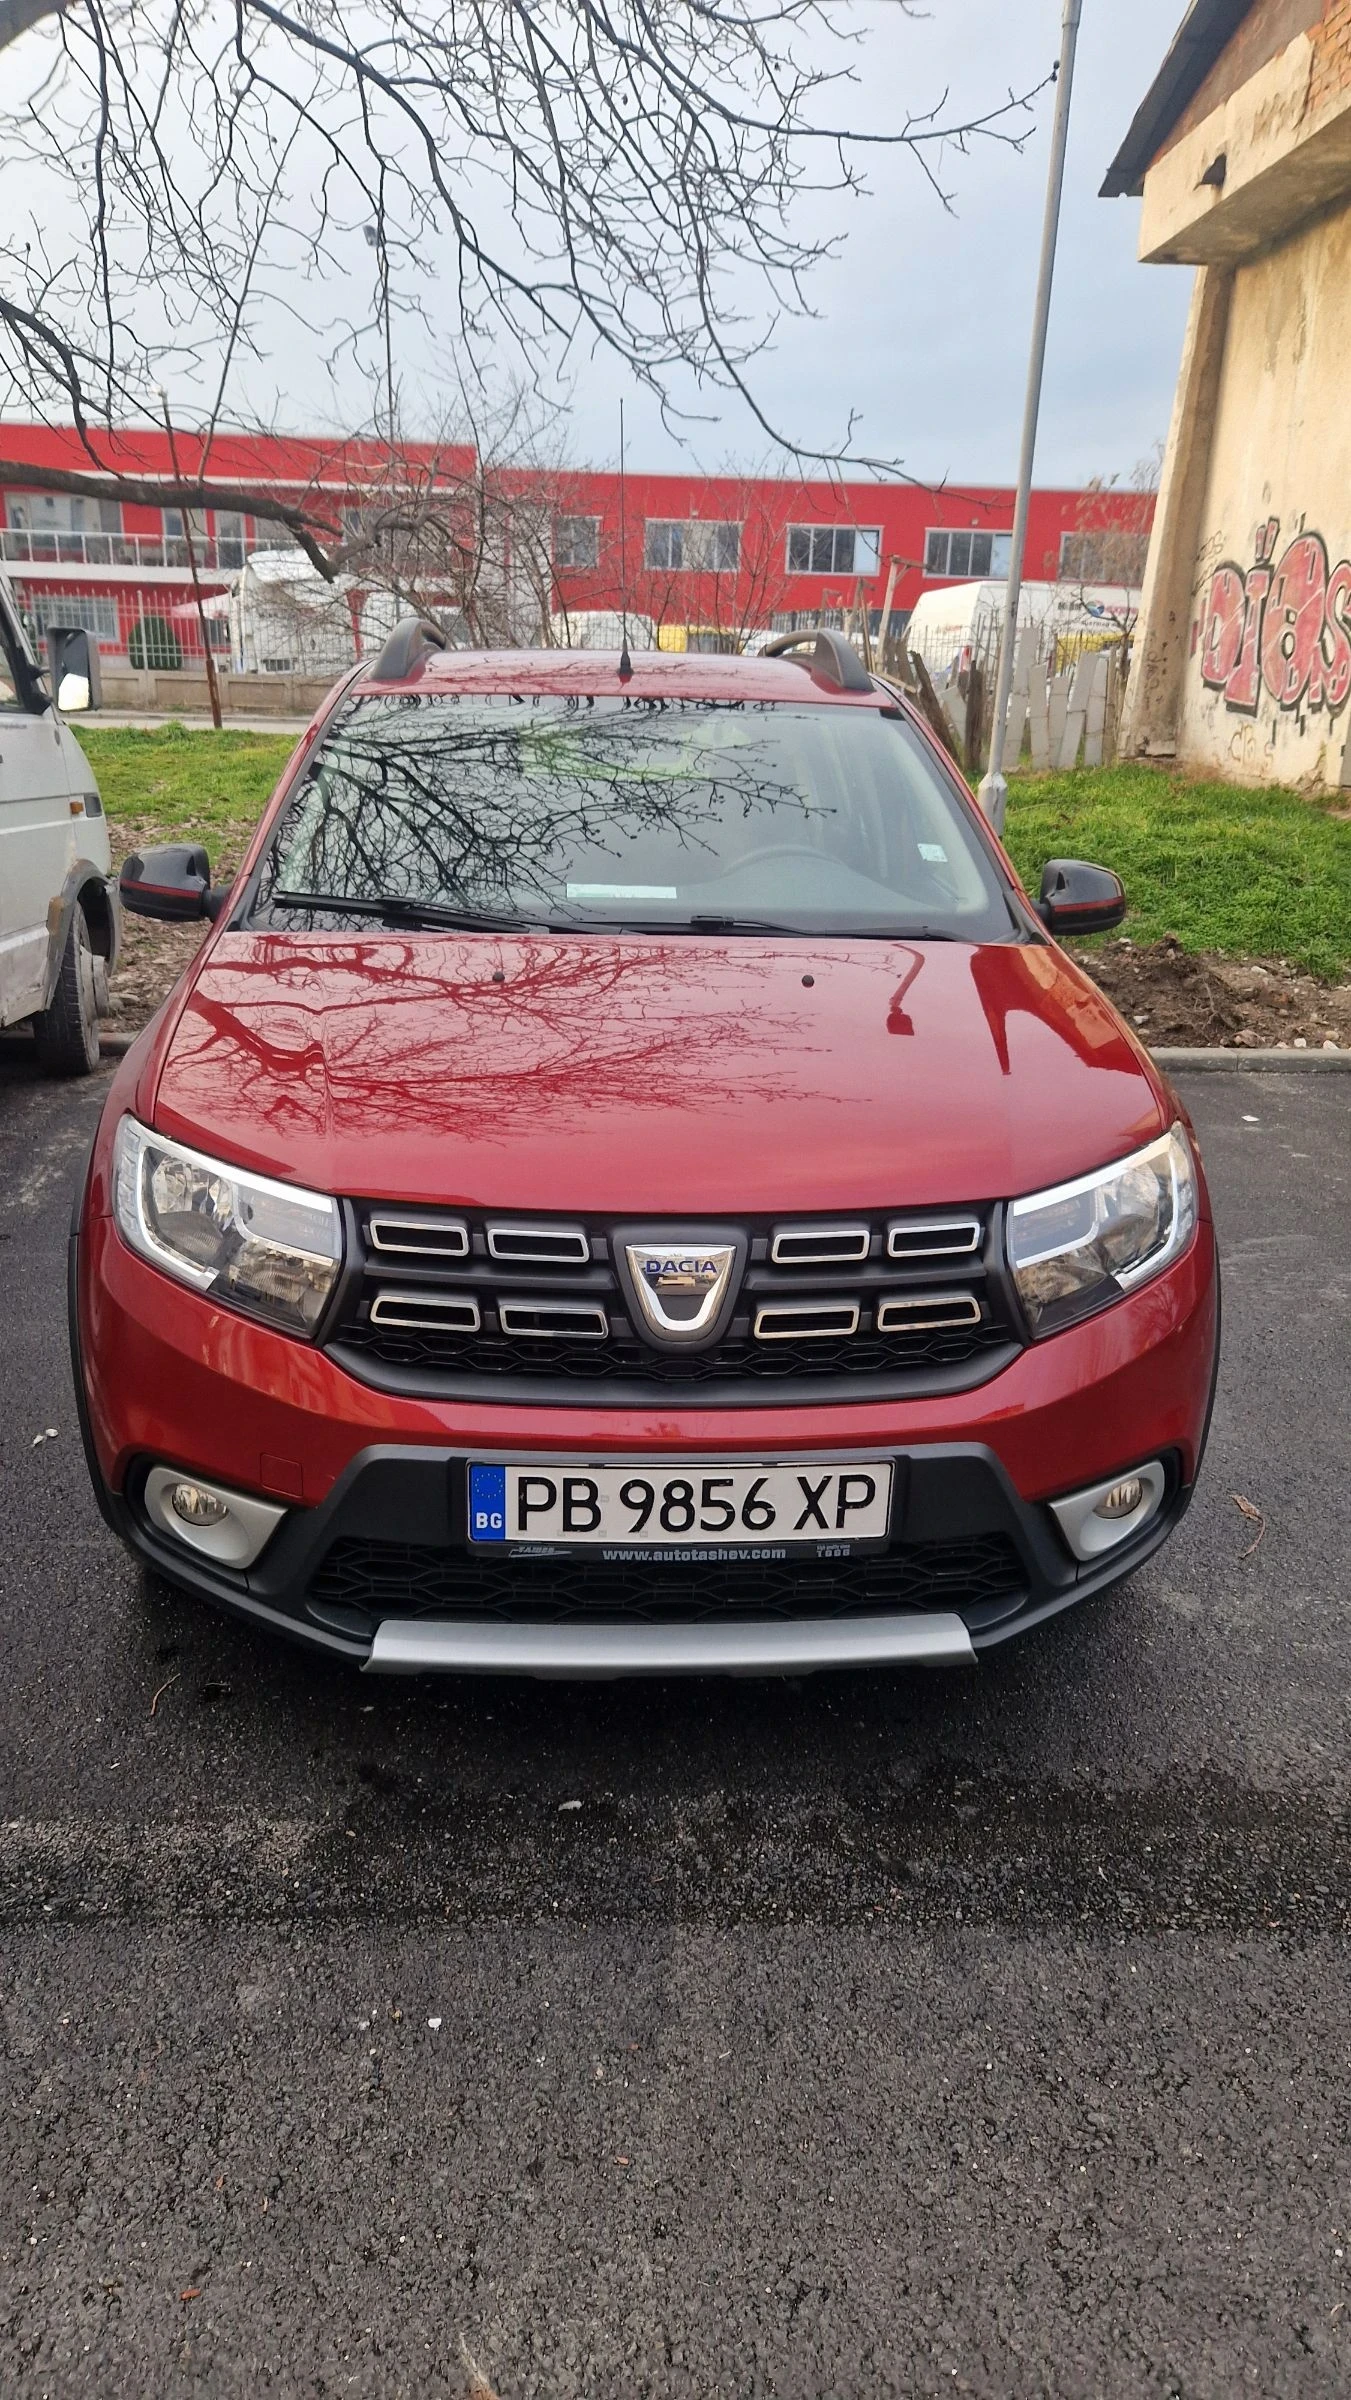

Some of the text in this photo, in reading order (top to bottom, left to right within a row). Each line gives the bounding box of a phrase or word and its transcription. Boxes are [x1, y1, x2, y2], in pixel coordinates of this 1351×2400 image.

[646, 1260, 717, 1273] DACIA
[517, 1474, 876, 1533] PB 9856 XP
[475, 1512, 502, 1529] BG
[602, 1548, 786, 1562] www.autotashev.com
